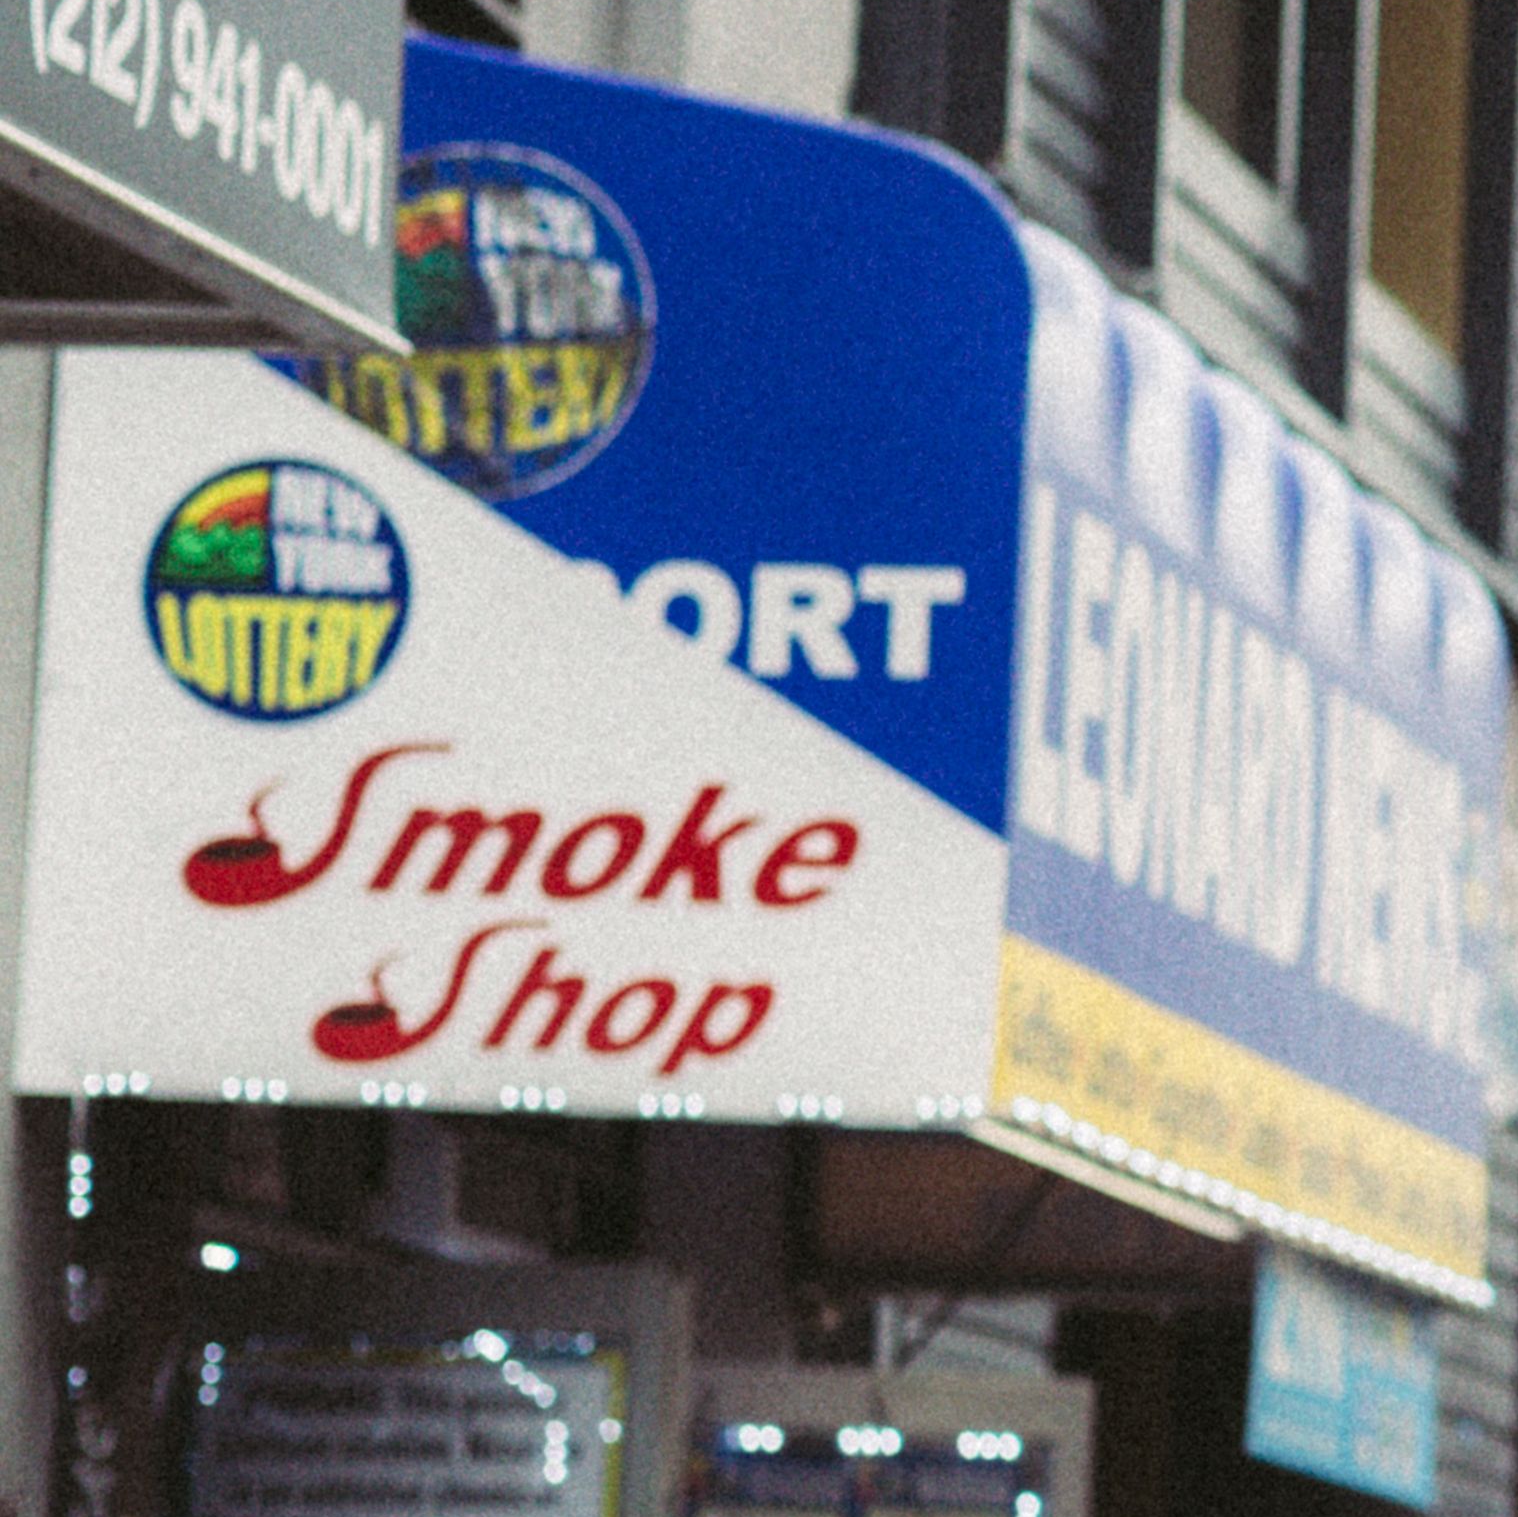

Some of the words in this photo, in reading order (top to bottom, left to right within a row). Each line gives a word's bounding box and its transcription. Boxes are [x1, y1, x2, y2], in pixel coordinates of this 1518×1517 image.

[155, 591, 398, 713] LOTTERY
[571, 559, 967, 682] ORT
[1017, 482, 1314, 970] LEONARD
[183, 740, 862, 910] Smoke
[311, 918, 776, 1077] Shop
